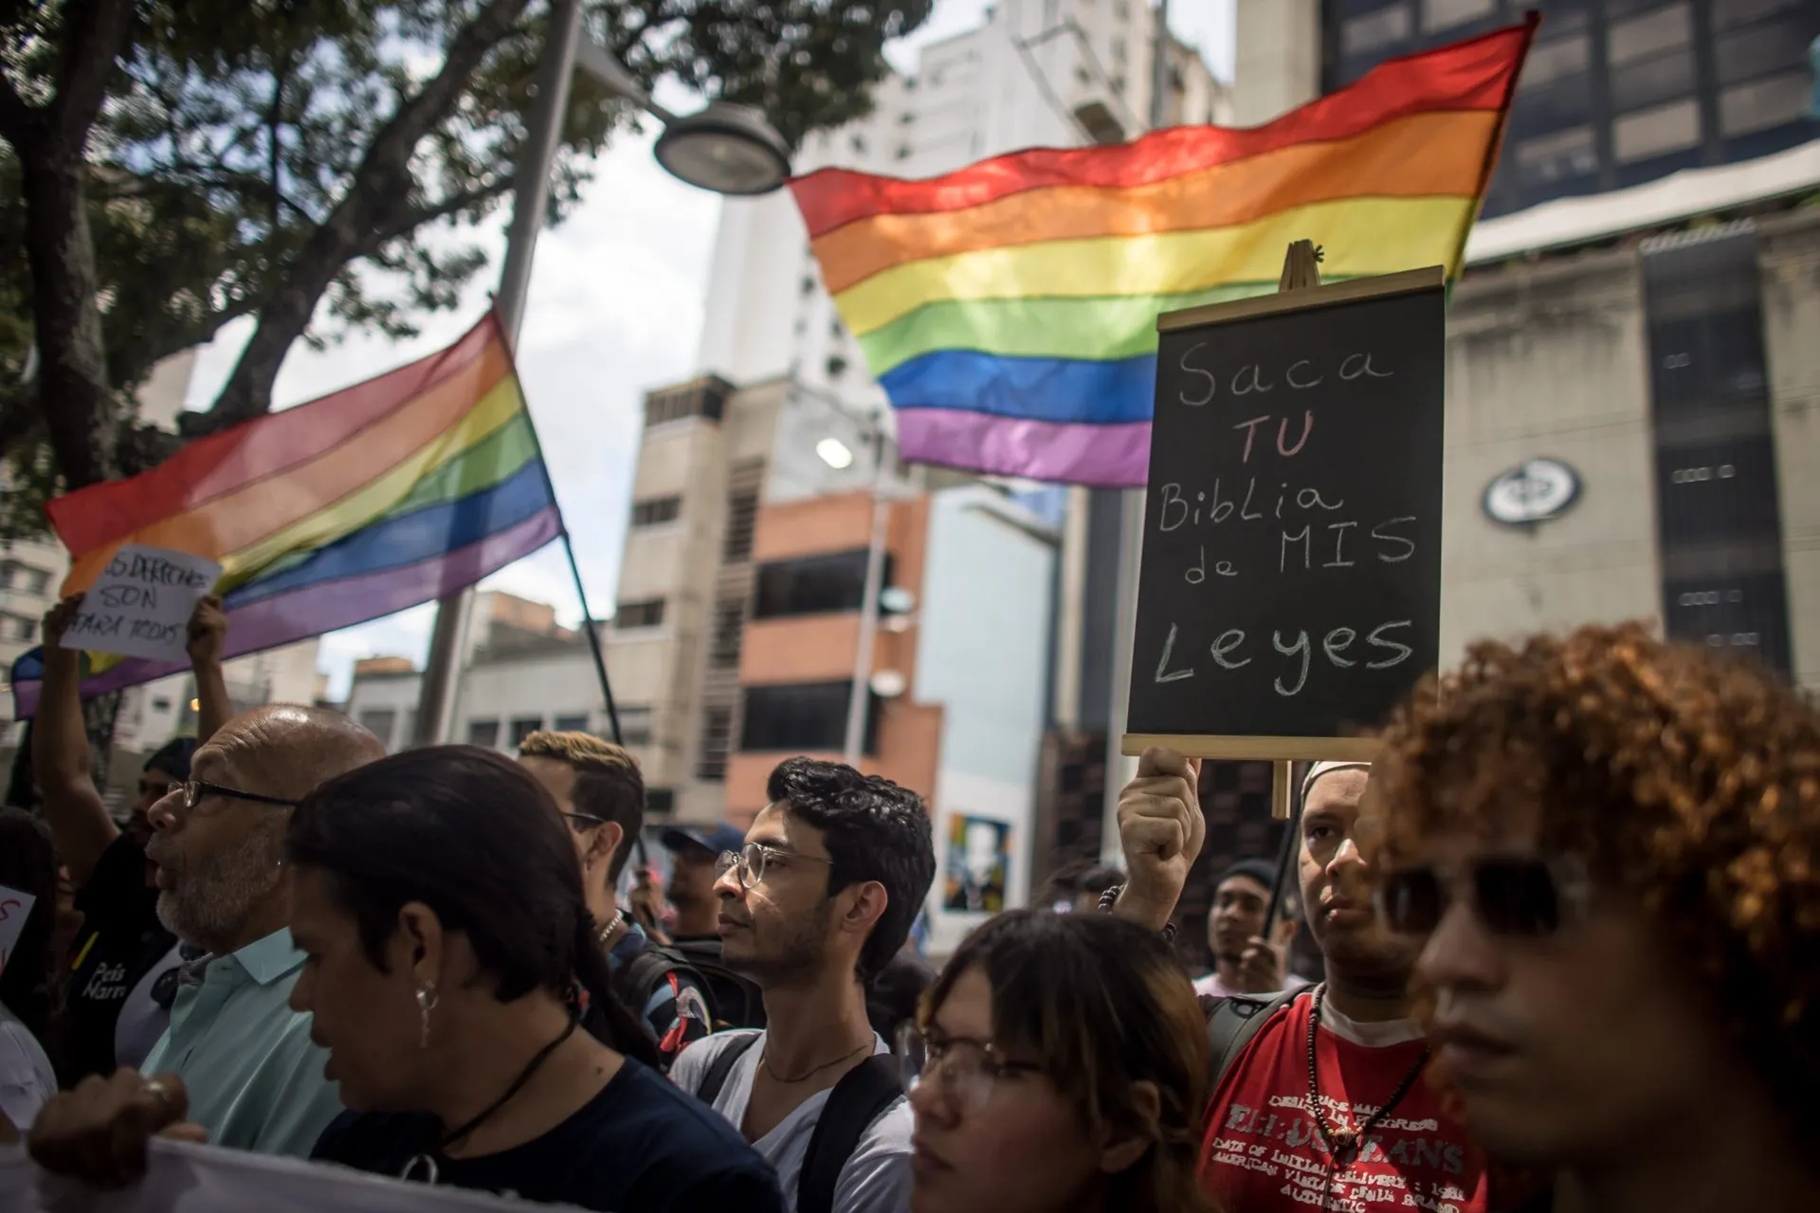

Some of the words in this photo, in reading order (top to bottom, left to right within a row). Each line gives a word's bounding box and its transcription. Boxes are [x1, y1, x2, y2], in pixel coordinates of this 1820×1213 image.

[1179, 342, 1394, 406] Saca
[1232, 409, 1315, 464] TU
[1184, 545, 1238, 584] de
[1280, 516, 1416, 573] MIS
[99, 584, 157, 610] SON
[1154, 620, 1414, 697] Leyes
[1249, 1144, 1268, 1157] OF
